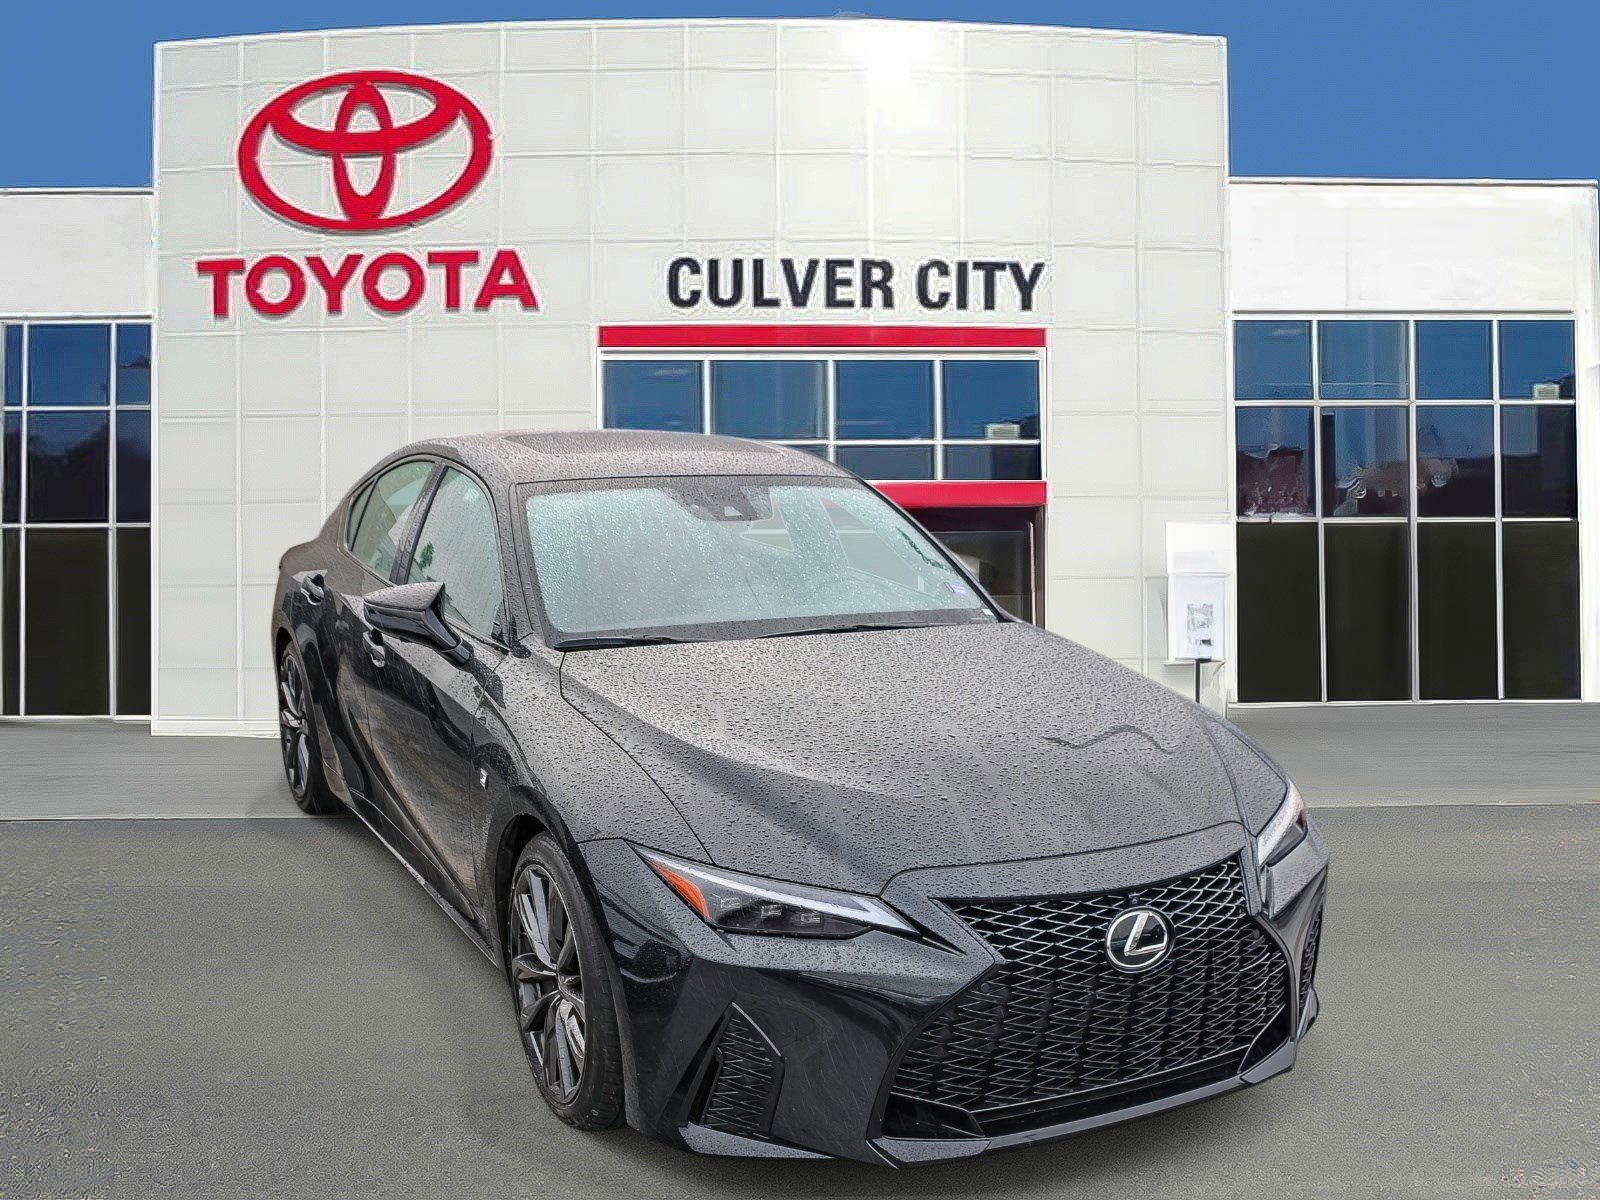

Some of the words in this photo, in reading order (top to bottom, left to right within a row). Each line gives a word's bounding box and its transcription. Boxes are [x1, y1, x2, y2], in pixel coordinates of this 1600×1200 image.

[196, 250, 539, 318] TOYOTA
[667, 257, 895, 309] CULVER
[916, 259, 1046, 312] CITY
